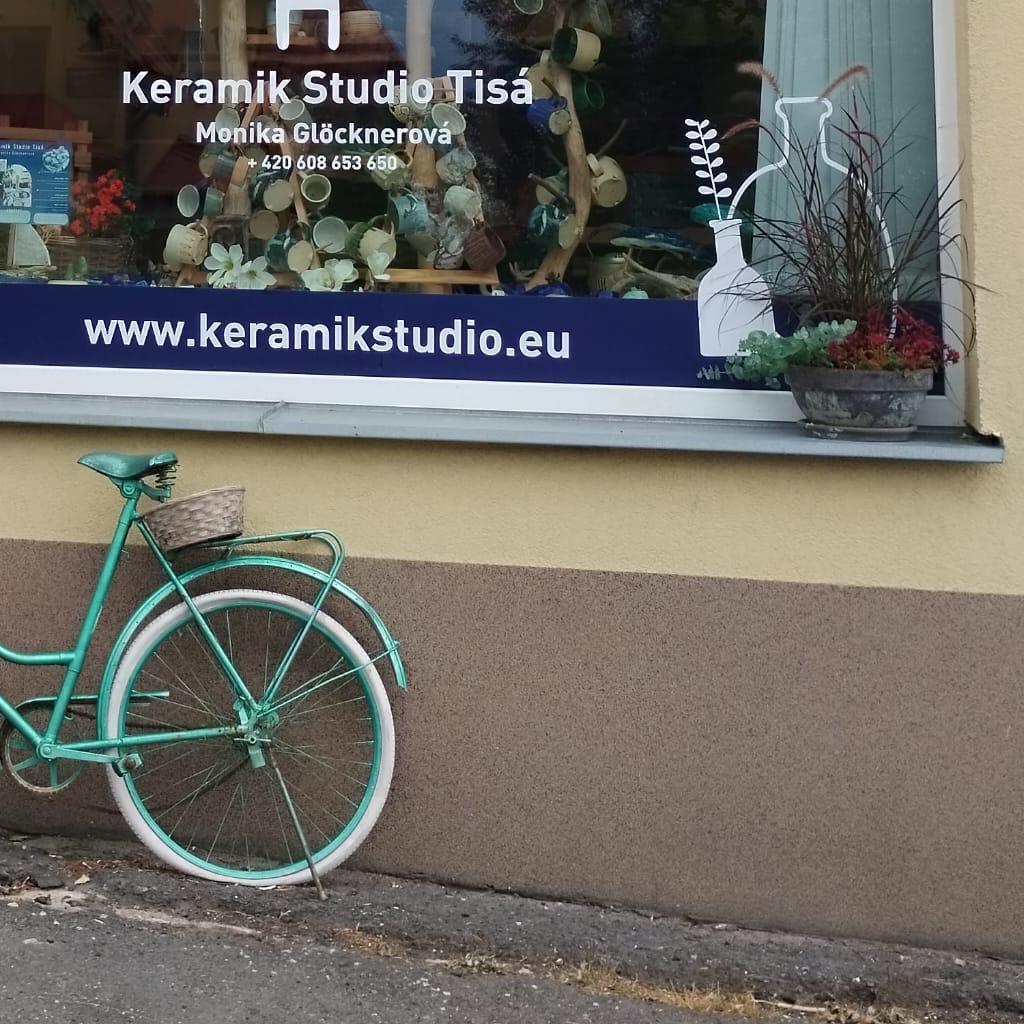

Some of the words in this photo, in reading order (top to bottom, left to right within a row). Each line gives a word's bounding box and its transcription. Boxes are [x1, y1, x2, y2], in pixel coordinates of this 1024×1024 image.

[122, 70, 292, 104] Keramik
[303, 70, 434, 105] Studio
[446, 67, 533, 105] Tisá
[196, 121, 285, 145] Monika
[292, 121, 452, 145] Glöcknerová
[247, 158, 258, 168] +
[261, 155, 292, 170] 420
[296, 155, 327, 170] 608
[331, 155, 362, 170] 653
[366, 155, 398, 171] 650
[84, 313, 570, 359] www.keramikstudio.eu
